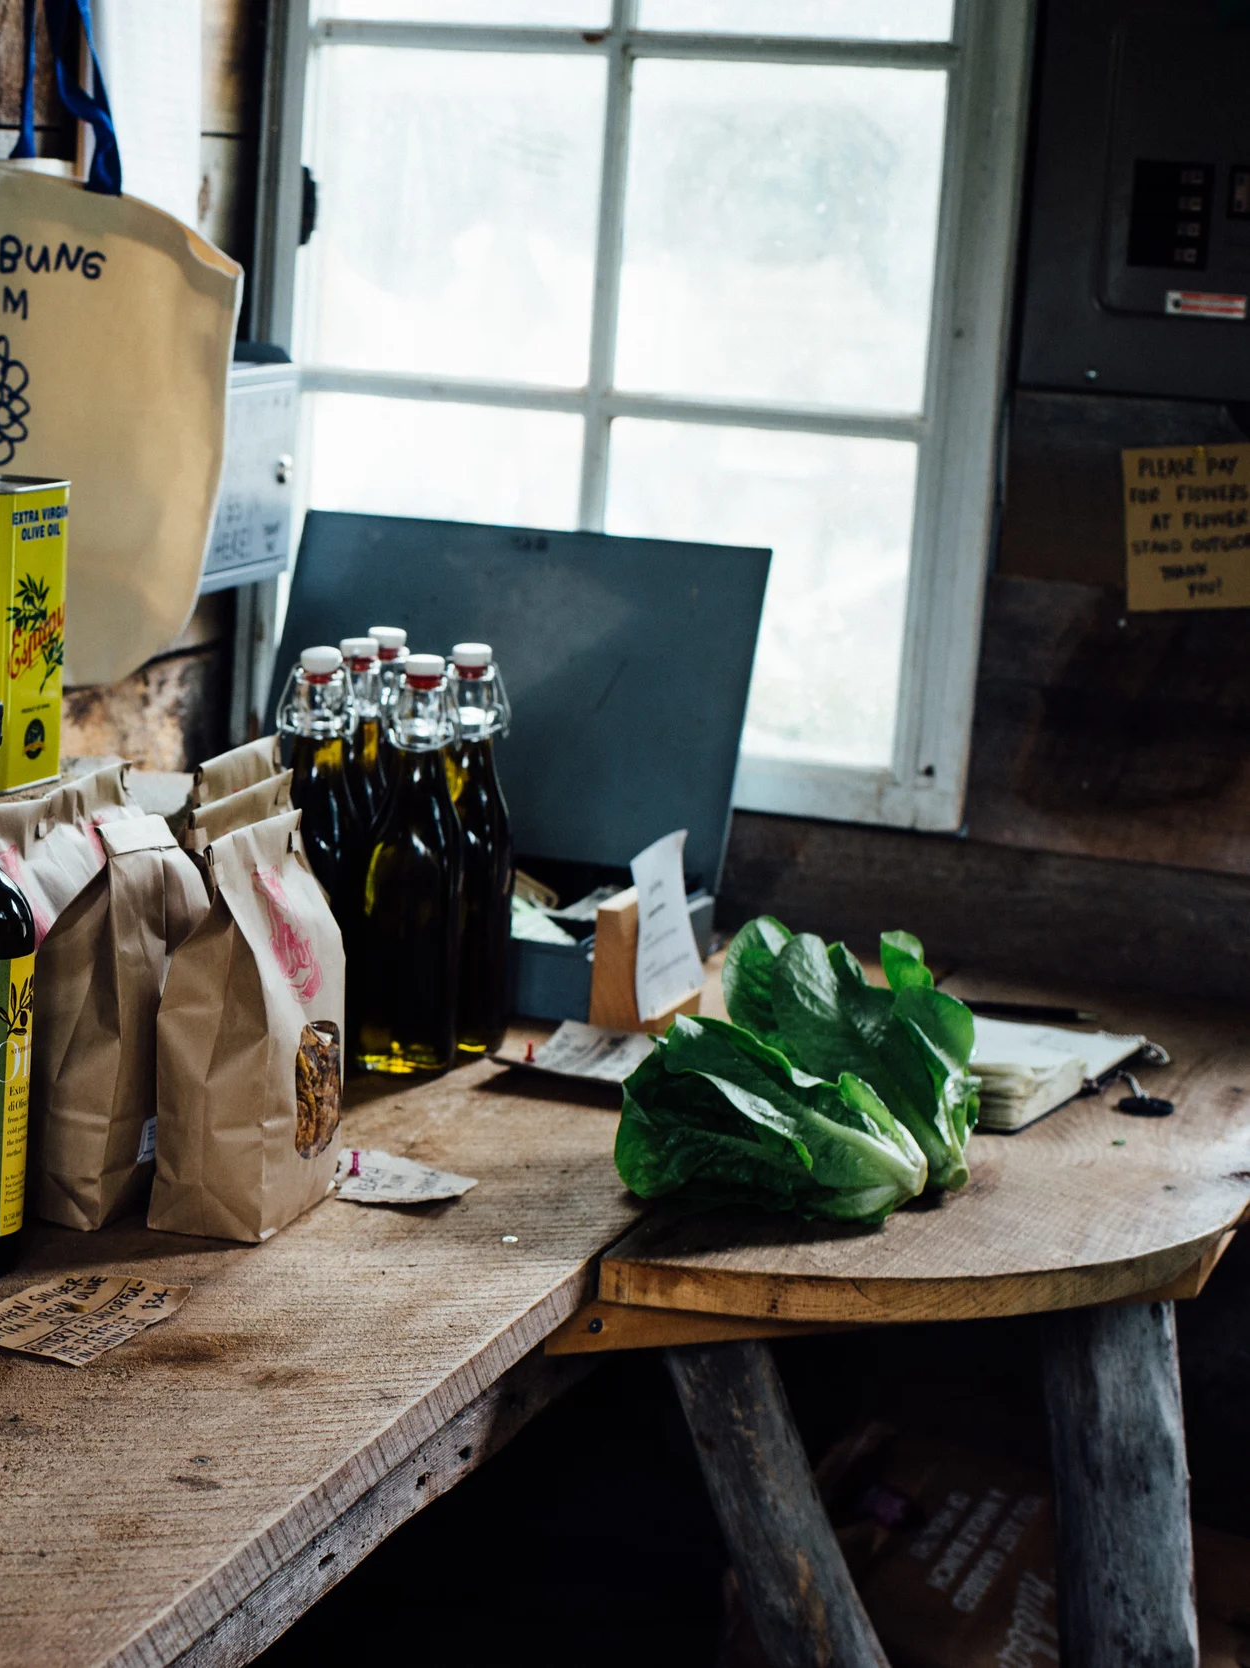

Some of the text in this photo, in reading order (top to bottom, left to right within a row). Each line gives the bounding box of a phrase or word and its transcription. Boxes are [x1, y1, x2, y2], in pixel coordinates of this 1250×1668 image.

[12, 509, 39, 526] EXTRA
[21, 523, 60, 541] OLIVE OIL
[8, 1101, 15, 1112] di
[29, 1278, 83, 1304] SINGER
[25, 1299, 73, 1323] VIRGIN
[24, 1328, 82, 1352] BUTTERY
[52, 1344, 76, 1359] THE
[74, 1314, 134, 1345] PERFECT
[69, 1326, 136, 1363] FINISHING
